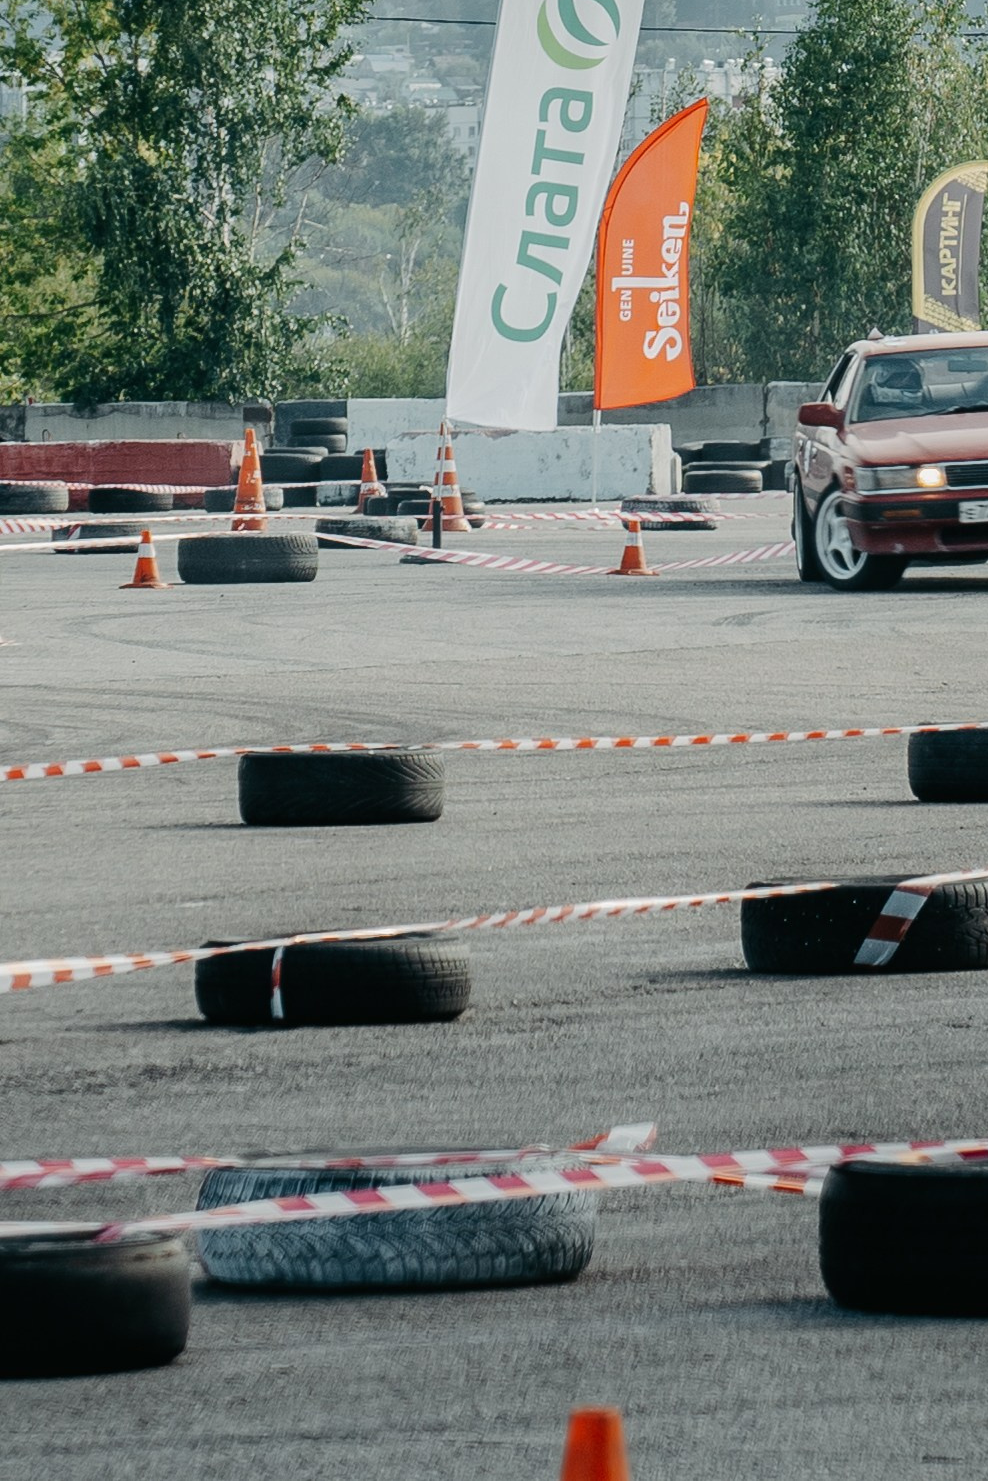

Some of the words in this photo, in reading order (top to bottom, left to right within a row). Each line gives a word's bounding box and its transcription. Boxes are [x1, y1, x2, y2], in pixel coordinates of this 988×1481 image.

[491, 87, 593, 343] Слата
[620, 238, 634, 321] GENUINE
[939, 192, 961, 295] КАРТИНГ
[612, 202, 689, 361] Seiken
